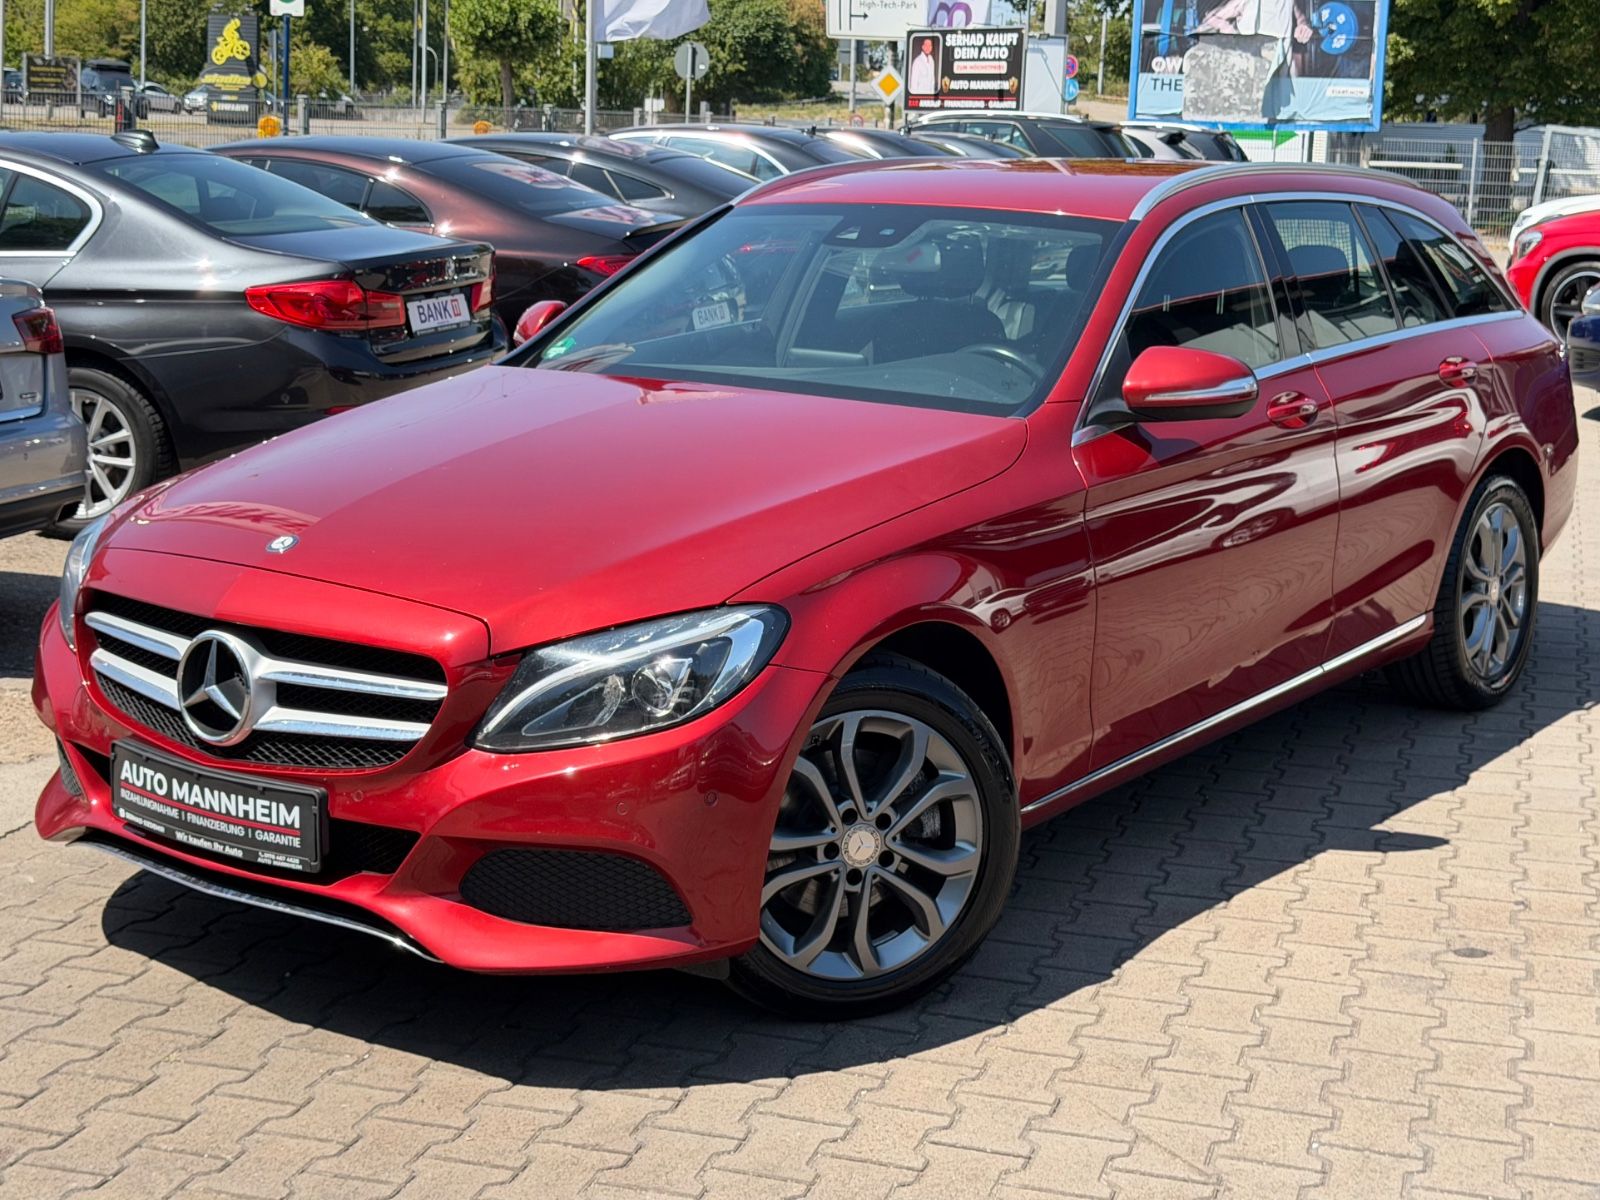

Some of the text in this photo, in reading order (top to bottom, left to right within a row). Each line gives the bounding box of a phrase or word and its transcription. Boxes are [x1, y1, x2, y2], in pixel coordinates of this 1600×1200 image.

[859, 0, 918, 10] High-Tech-Park
[945, 32, 1019, 47] SERHAD KAUFT
[953, 46, 1009, 60] DEIN AUTO
[949, 79, 969, 90] AUTO
[416, 300, 453, 324] BANK
[120, 760, 168, 796] AUTO
[172, 778, 300, 829] MANNHEIM
[186, 812, 246, 837] FINANZIERUNG
[255, 830, 302, 848] GARANTIE
[224, 845, 244, 858] Auto
